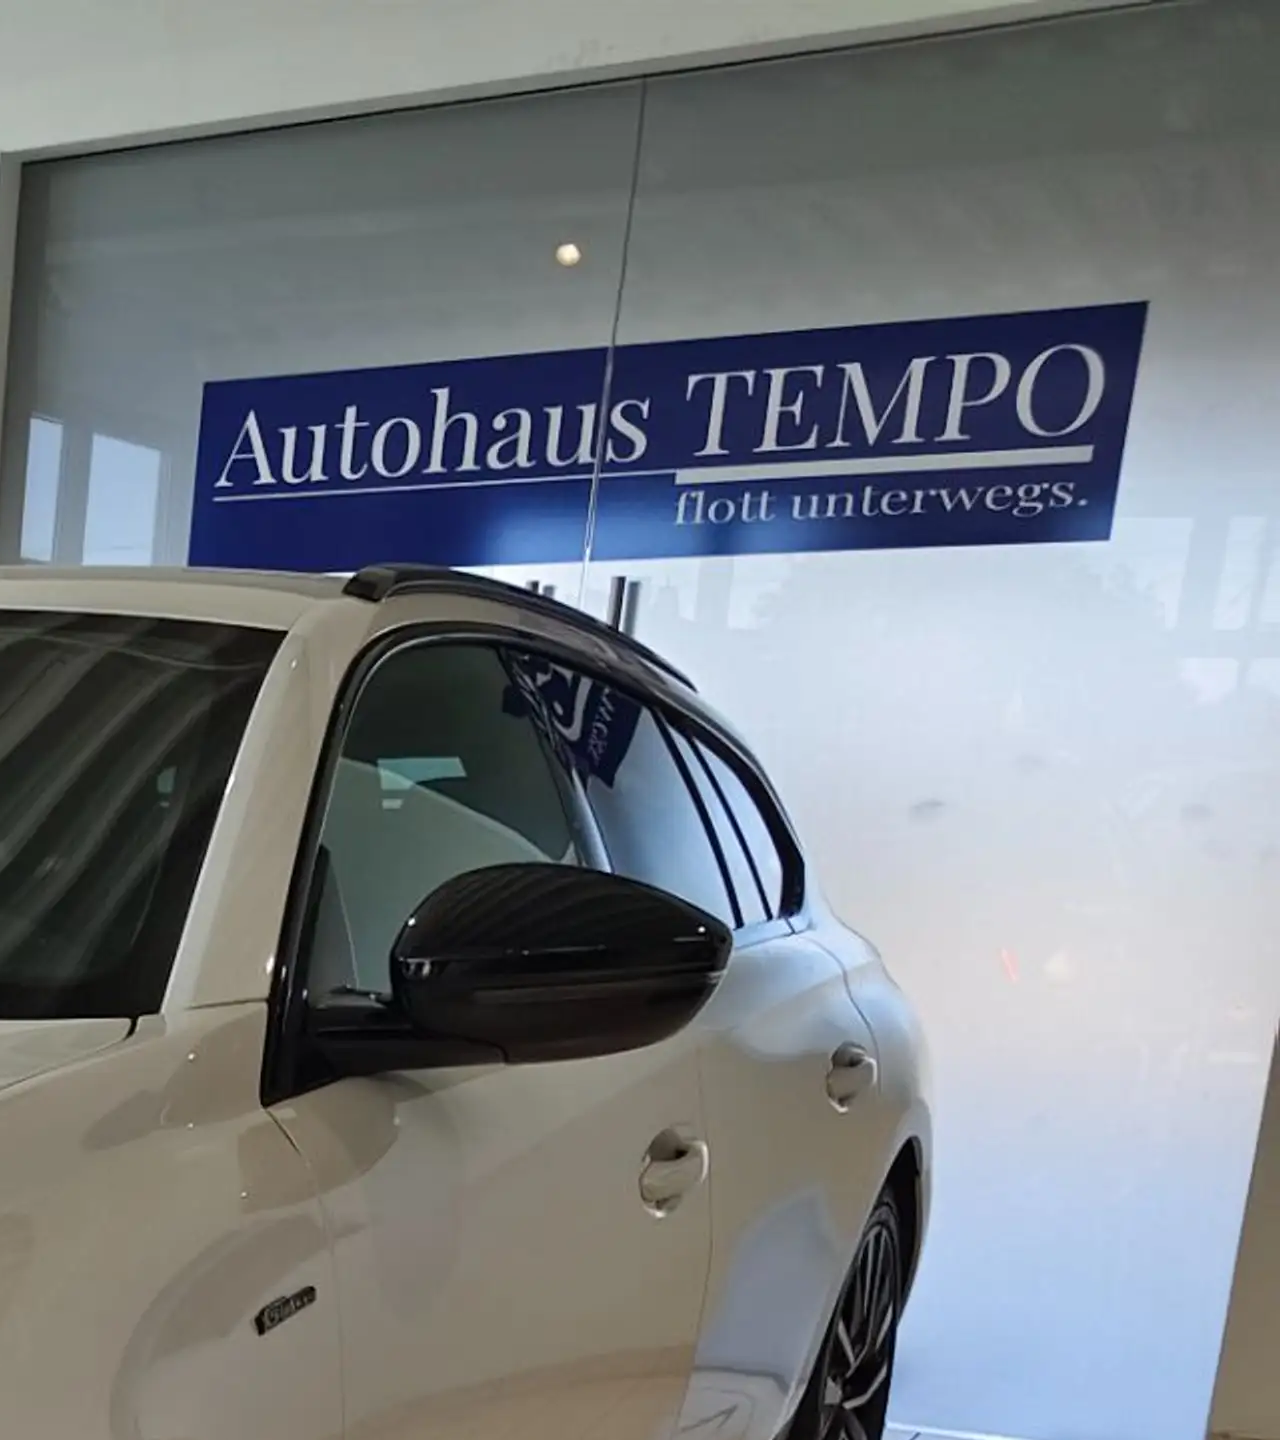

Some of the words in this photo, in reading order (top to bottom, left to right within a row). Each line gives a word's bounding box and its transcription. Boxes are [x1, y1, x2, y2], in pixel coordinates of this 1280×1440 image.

[214, 386, 650, 488] Autohaus
[686, 343, 1107, 456] TEMPO
[674, 489, 776, 526] flott
[790, 478, 1088, 517] unterwegs.
